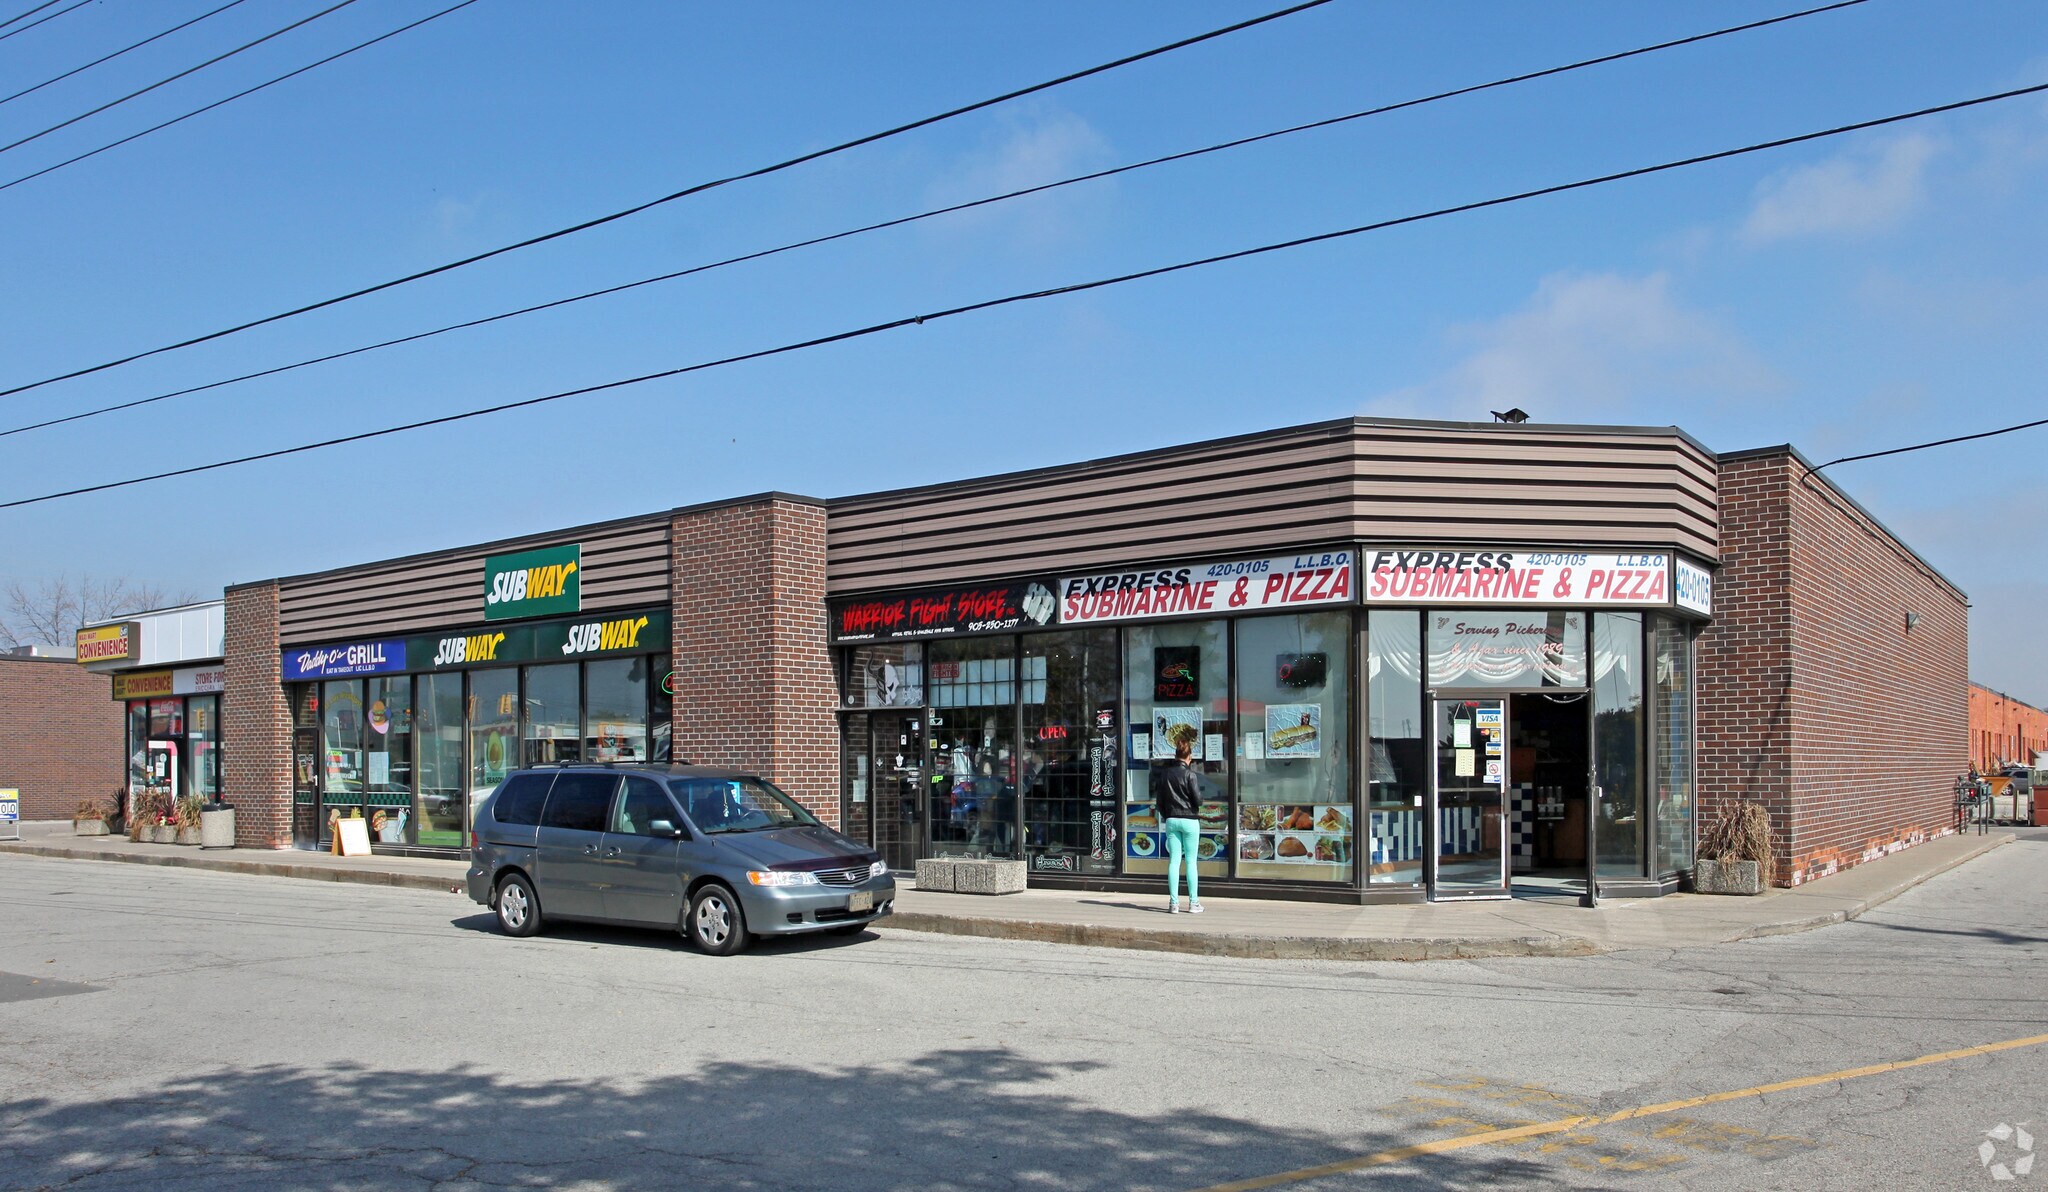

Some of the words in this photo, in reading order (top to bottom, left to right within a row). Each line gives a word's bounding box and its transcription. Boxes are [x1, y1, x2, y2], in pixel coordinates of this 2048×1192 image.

[1207, 560, 1270, 578] 420-0105
[1293, 552, 1350, 570] L.L.B.O.
[1371, 552, 1514, 576] EXPRESS
[1527, 553, 1587, 567] 420-0105
[1615, 554, 1665, 567] L.L.B.O.
[487, 560, 577, 606] SUBWAY
[1064, 580, 1218, 621] SUBMARINE
[1228, 576, 1250, 607] &
[1262, 566, 1349, 604] PIZZA
[1065, 569, 1191, 599] EXPRESS
[1371, 566, 1544, 598] SUBMARINE
[1553, 567, 1571, 598] &
[1584, 569, 1665, 600] PIZZA
[1676, 565, 1710, 606] 420-0105
[843, 600, 906, 633] WARRIOR
[909, 593, 955, 628] FIGHT
[958, 589, 1008, 622] STORE
[562, 615, 648, 655] SUBWAY
[1454, 622, 1499, 638] Serving
[80, 637, 128, 659] CONVENIENCE
[347, 643, 386, 665] GRILL
[434, 631, 505, 666] SUBWAY
[1535, 643, 1564, 656] 1989
[127, 675, 171, 693] CONVENIENCE
[1158, 684, 1195, 697] PIZZA
[1039, 725, 1067, 739] OPEN
